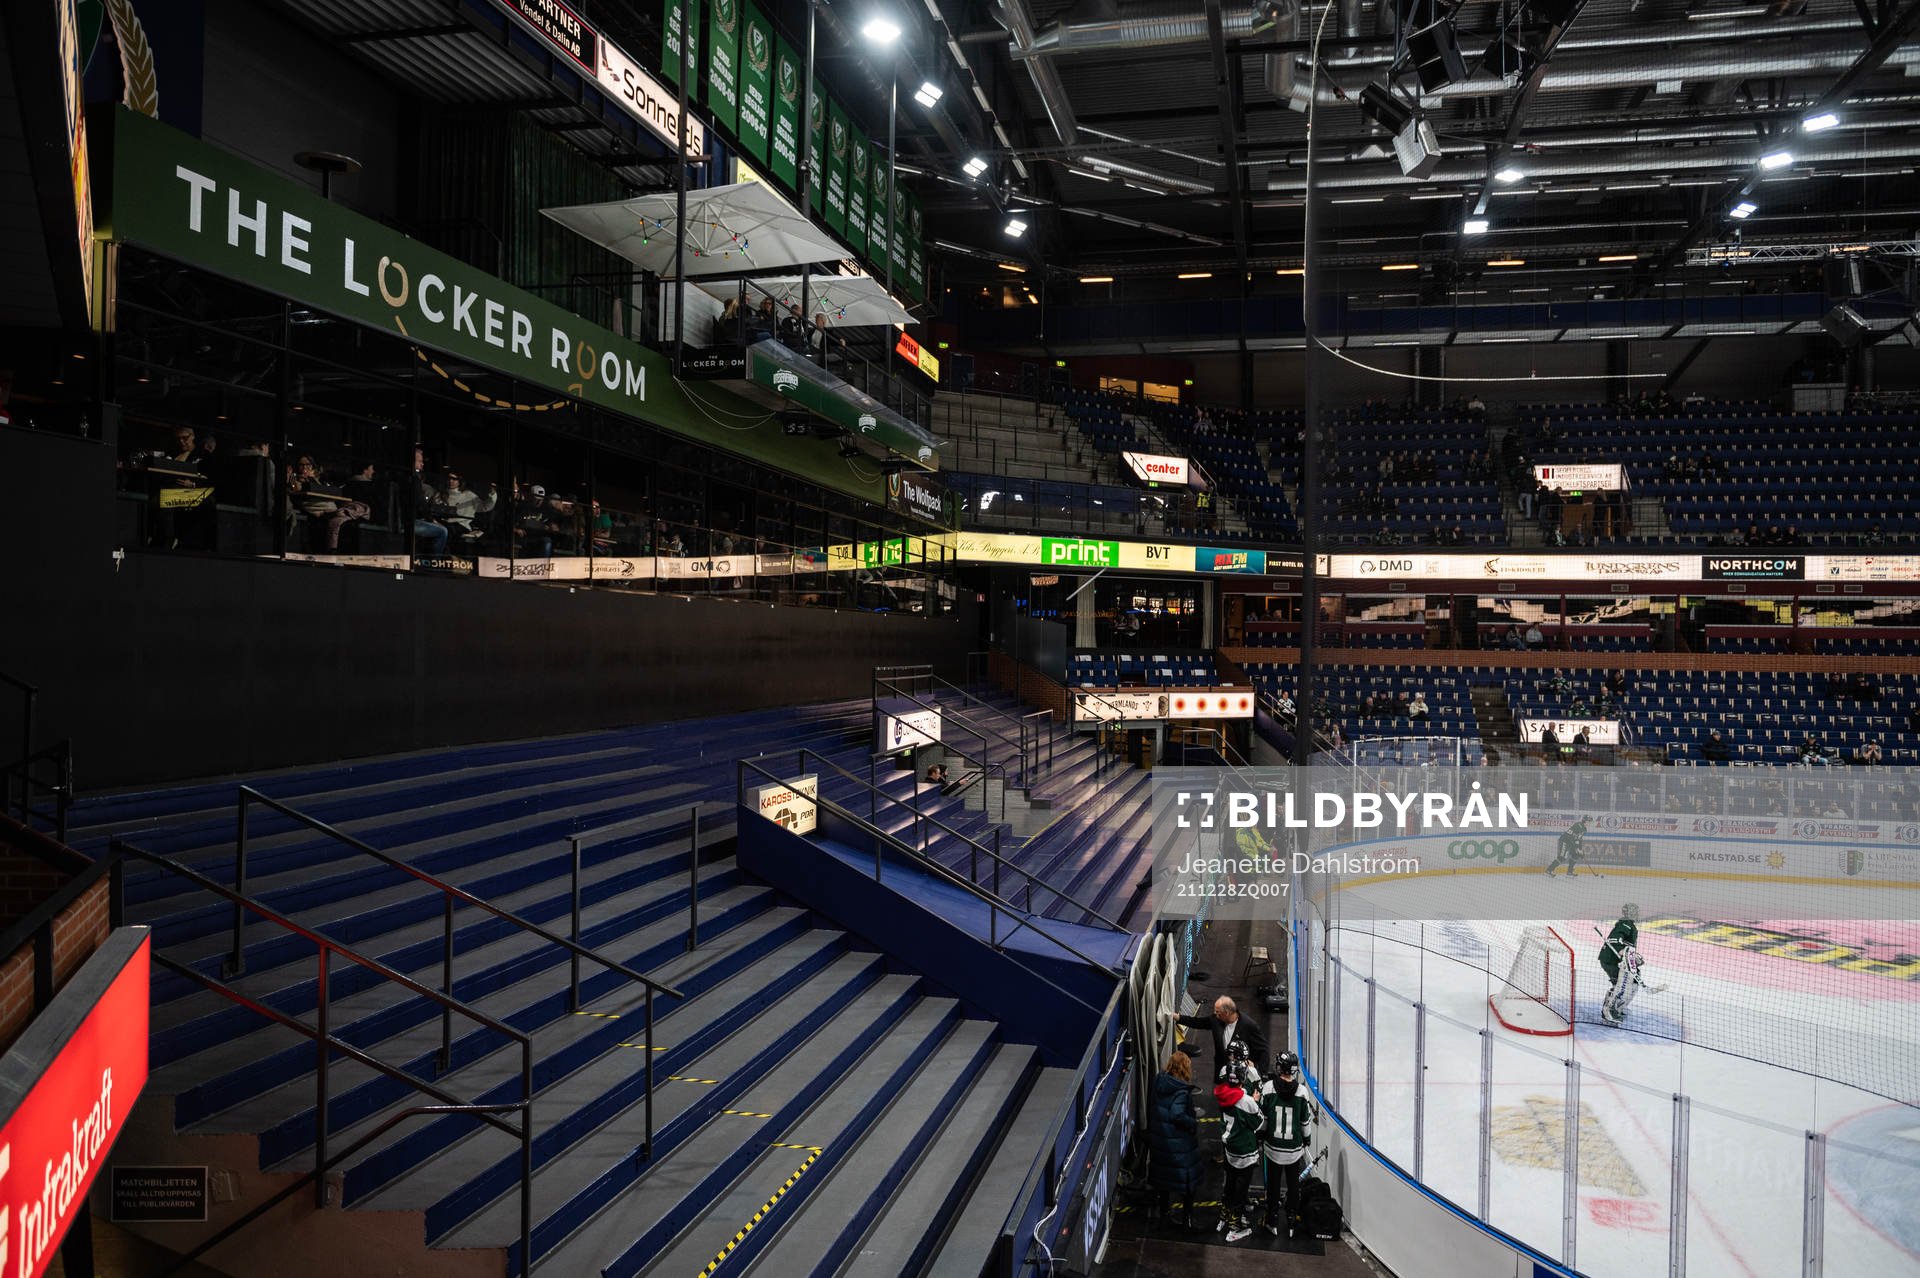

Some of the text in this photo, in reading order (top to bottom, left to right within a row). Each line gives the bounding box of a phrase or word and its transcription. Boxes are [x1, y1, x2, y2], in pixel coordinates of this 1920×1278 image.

[531, 0, 581, 40] ARTNER
[552, 26, 571, 50] Dalin
[570, 41, 581, 57] AB
[176, 165, 646, 402] THE LOCKER ROOM
[1146, 463, 1180, 475] center
[903, 480, 942, 512] The Wolfpack
[1051, 539, 1110, 564] print
[1145, 546, 1171, 560] BVT
[1379, 560, 1413, 571] DMD
[1709, 560, 1797, 570] NORTHCOM
[1447, 839, 1520, 863] coop
[1689, 852, 1761, 863] KARLSTAD.SE
[1273, 1105, 1294, 1140] 11
[19, 1066, 113, 1278] Infrakraft
[120, 1178, 198, 1187] MATCHBILJETTEN
